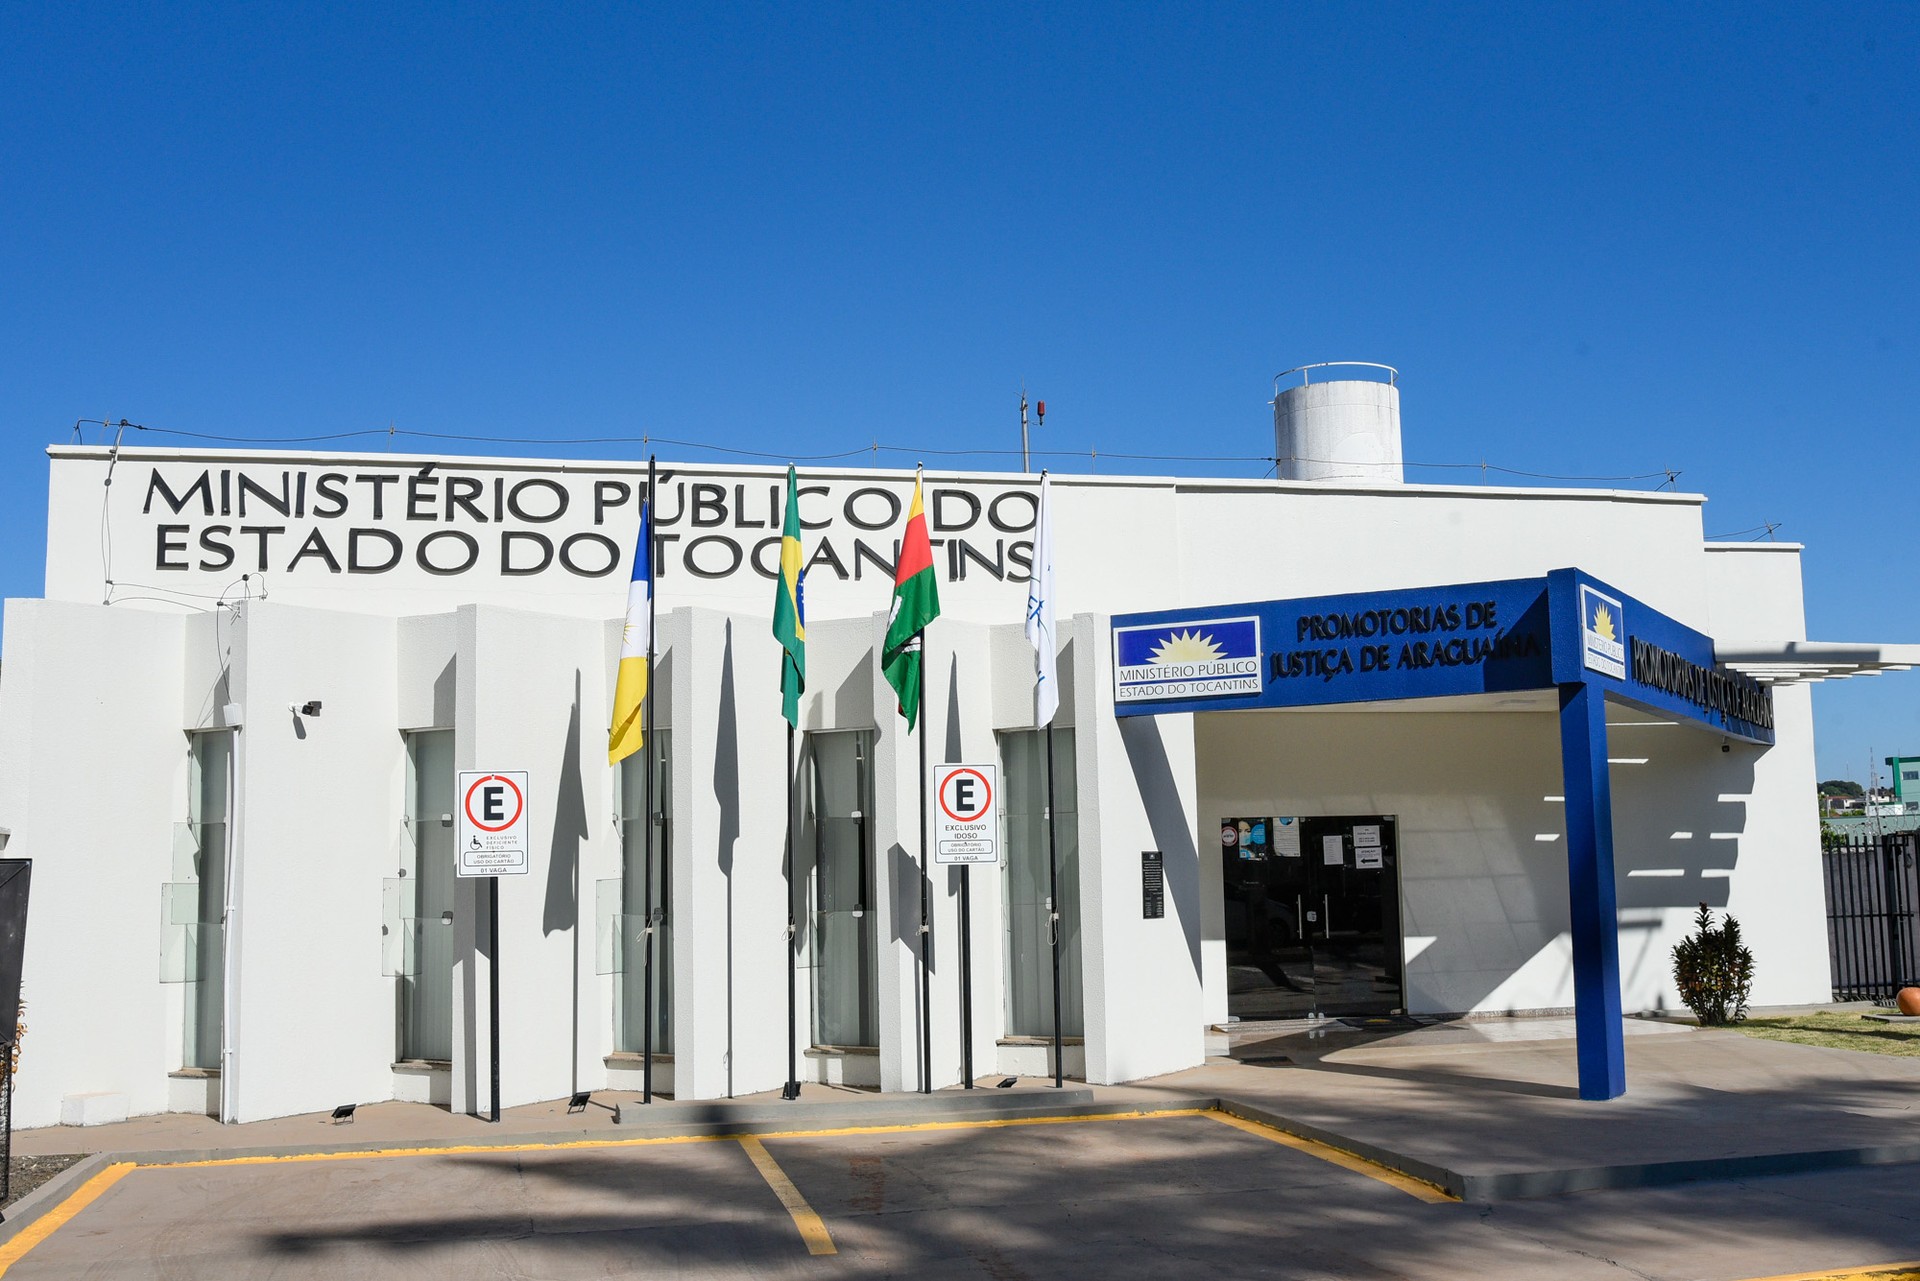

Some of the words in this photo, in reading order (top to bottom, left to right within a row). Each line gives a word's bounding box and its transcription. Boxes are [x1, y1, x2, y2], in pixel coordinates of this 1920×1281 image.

[143, 462, 569, 524] MINISTÉRIO
[594, 470, 902, 531] PÚBLICO
[932, 489, 1039, 533] DO
[156, 525, 479, 577] ESTADO
[501, 531, 620, 578] DO
[653, 533, 1034, 583] TOCANINS
[1297, 603, 1461, 642] PROMOTORIAS
[1466, 600, 1497, 629] DE
[1120, 665, 1194, 681] MINISTÉRIO
[1198, 661, 1257, 676] PÚBLICO
[1269, 647, 1354, 683] JUSTIÇA
[1361, 644, 1391, 672] DE
[1120, 685, 1164, 698] ESTADO
[1168, 683, 1186, 695] DO
[1191, 679, 1259, 693] TOCANTINS
[484, 787, 504, 821] E
[956, 779, 975, 811] E
